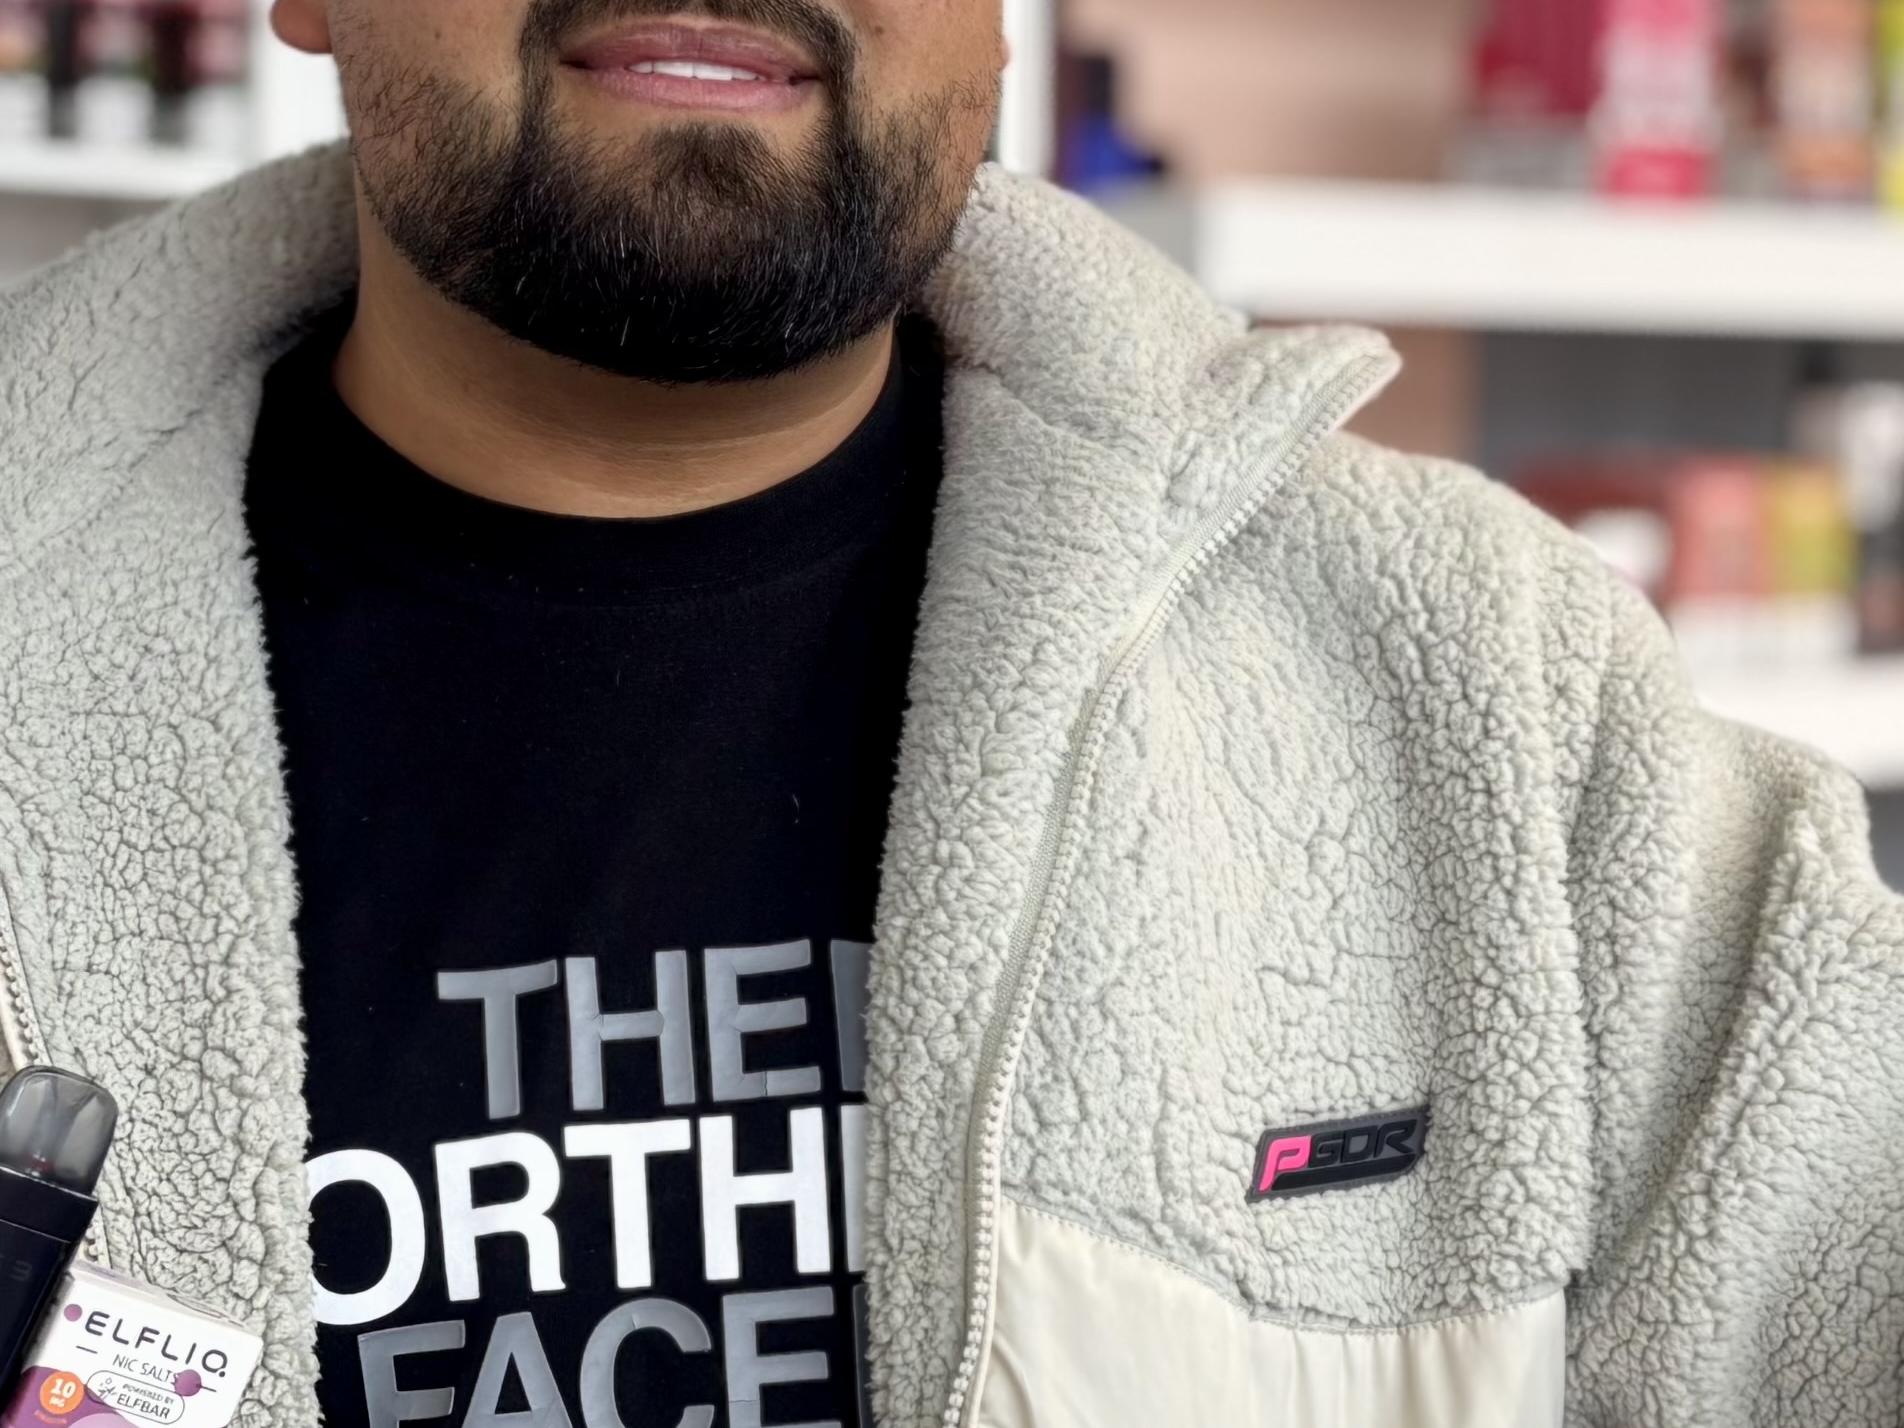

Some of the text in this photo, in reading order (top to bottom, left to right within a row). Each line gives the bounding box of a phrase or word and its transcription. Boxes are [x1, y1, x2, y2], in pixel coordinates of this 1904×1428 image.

[436, 938, 823, 1120] THE
[304, 1105, 832, 1326] ORTH
[112, 1353, 139, 1373] NIC
[49, 1378, 77, 1399] 10
[116, 1393, 171, 1420] ELFBAR
